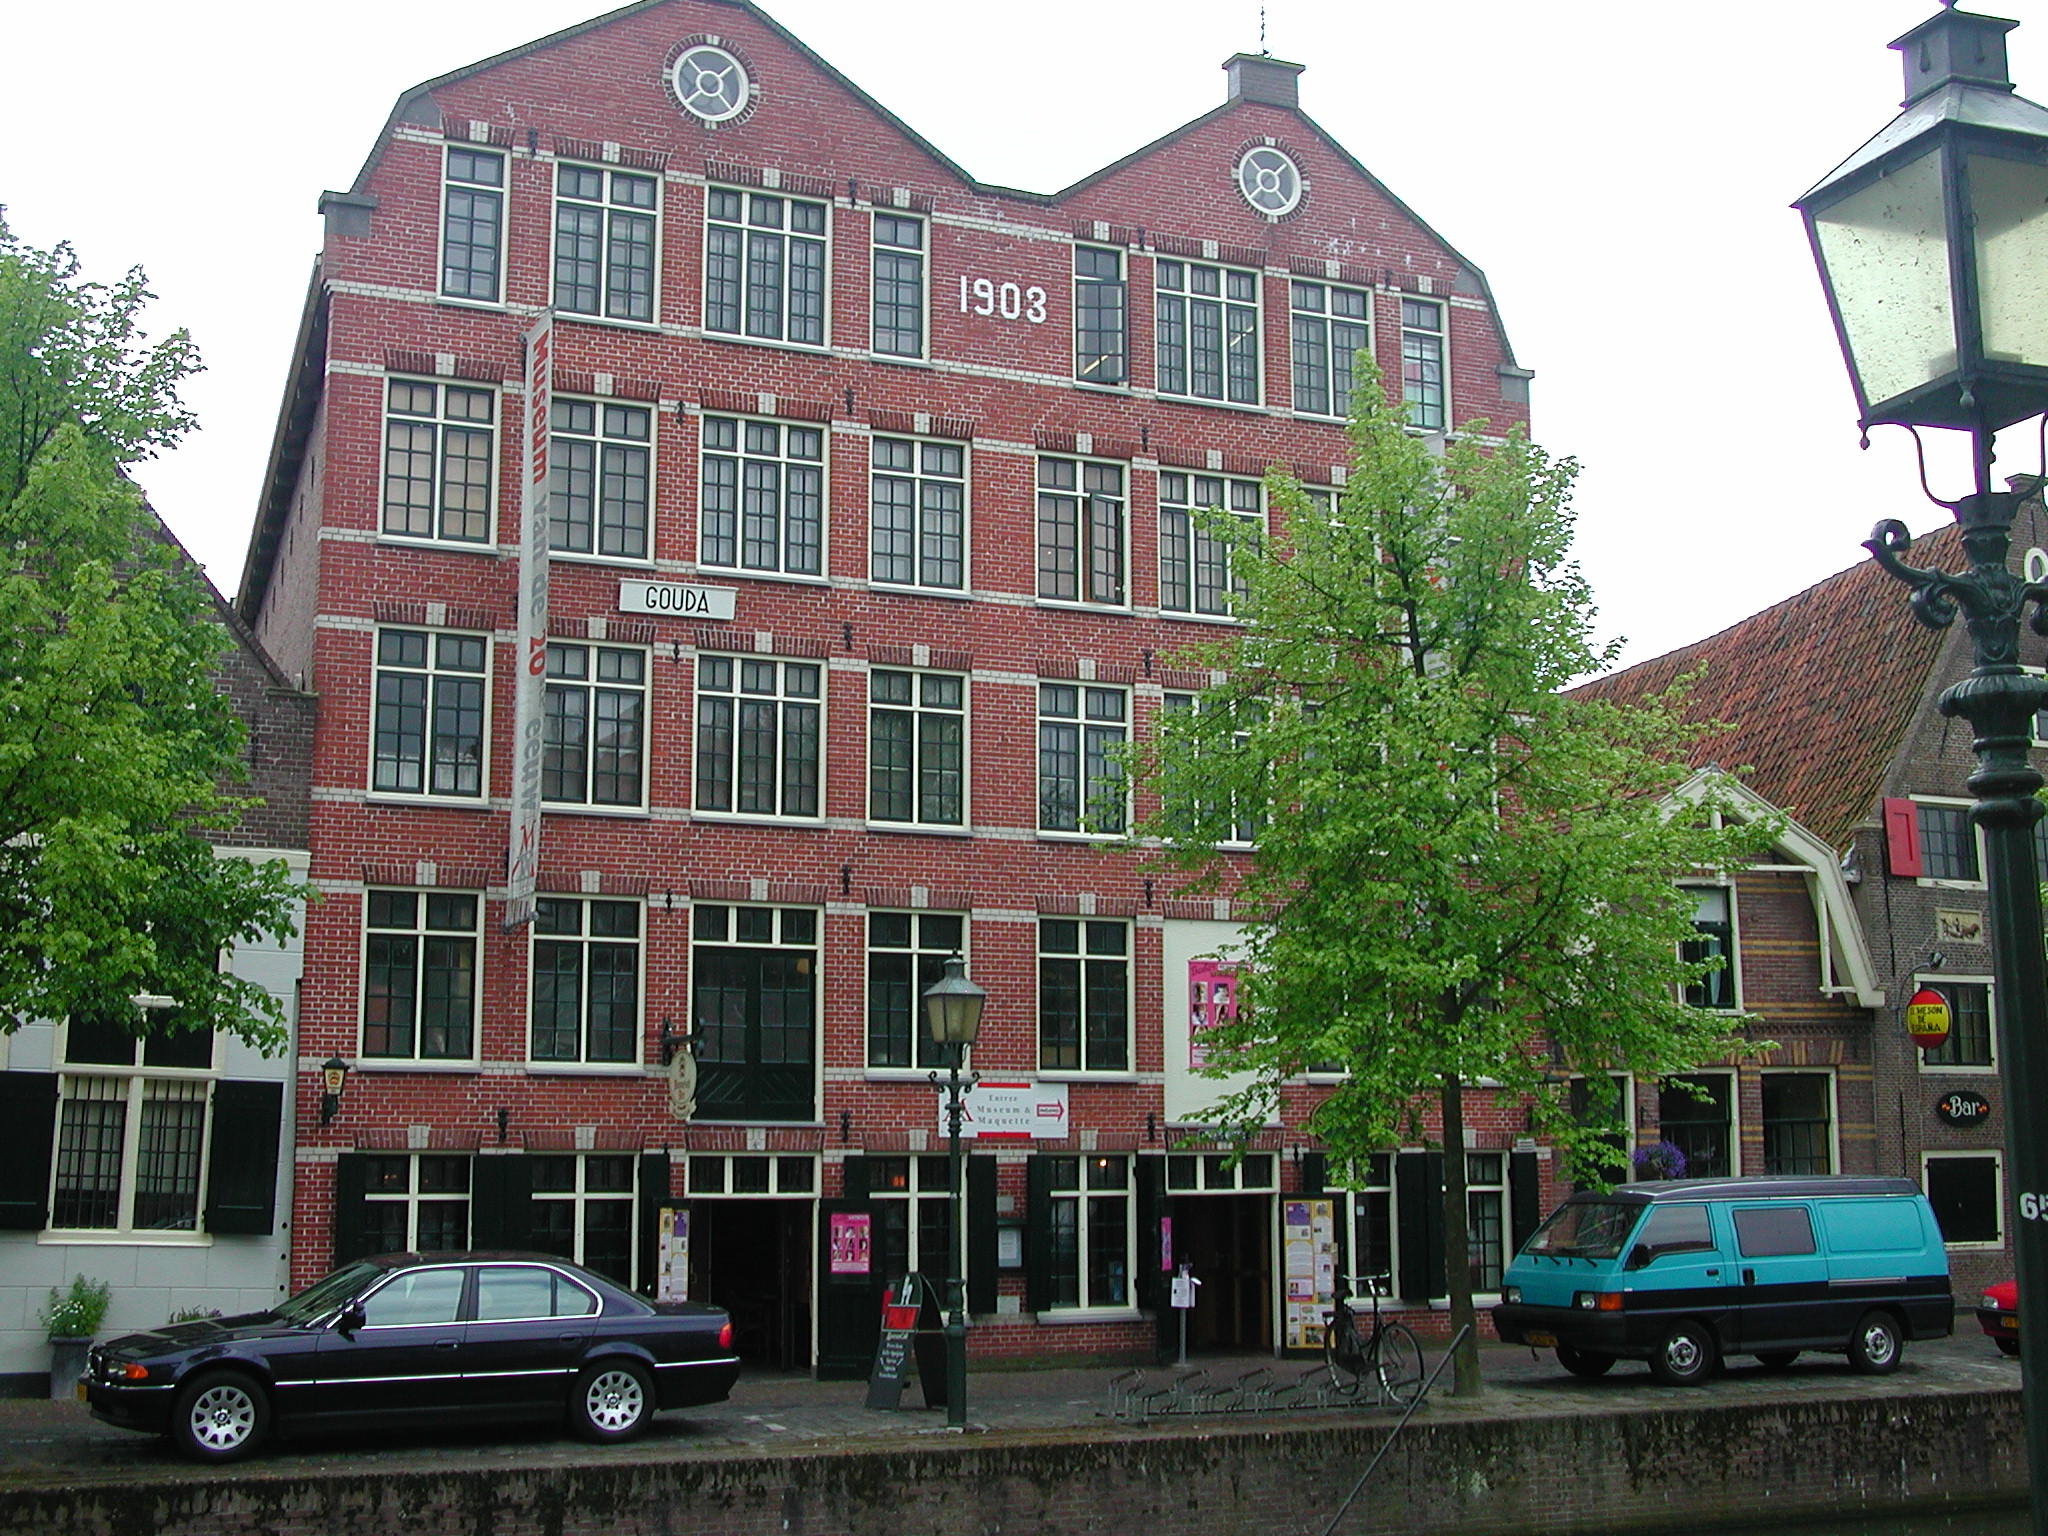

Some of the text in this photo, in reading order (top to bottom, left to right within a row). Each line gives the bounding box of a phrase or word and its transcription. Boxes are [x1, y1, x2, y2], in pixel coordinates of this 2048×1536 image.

[960, 275, 1047, 324] 1903
[533, 329, 549, 485] Museum
[532, 493, 548, 561] van
[531, 575, 548, 619] de
[645, 586, 709, 614] GOUDA
[521, 717, 542, 809] eeuw
[977, 1105, 1020, 1114] Museum
[1024, 1106, 1031, 1114] &
[978, 1116, 1030, 1126] Maquette
[1950, 1095, 1980, 1118] Bar
